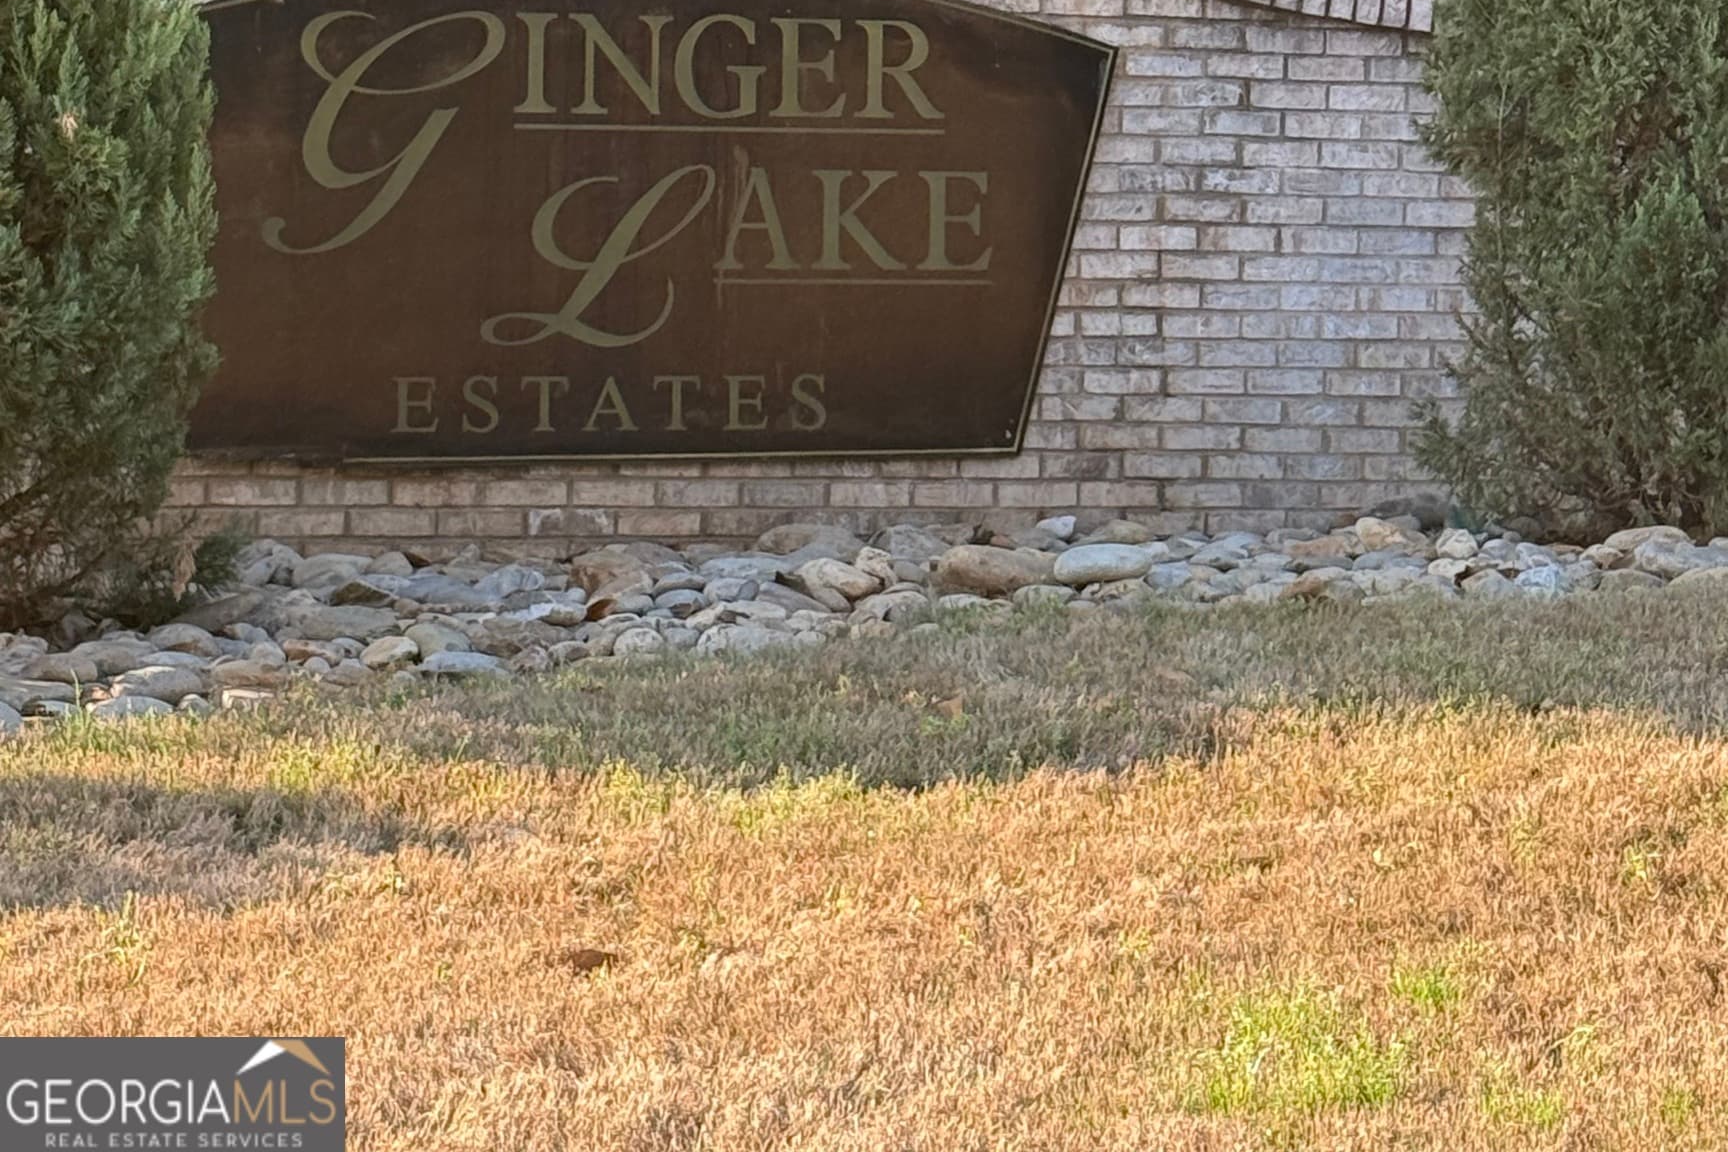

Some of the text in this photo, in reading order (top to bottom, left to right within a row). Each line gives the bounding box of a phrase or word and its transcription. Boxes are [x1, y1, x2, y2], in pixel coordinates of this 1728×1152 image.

[261, 10, 945, 255] GINGER
[480, 163, 993, 349] LAKE
[391, 373, 829, 435] ESTATES
